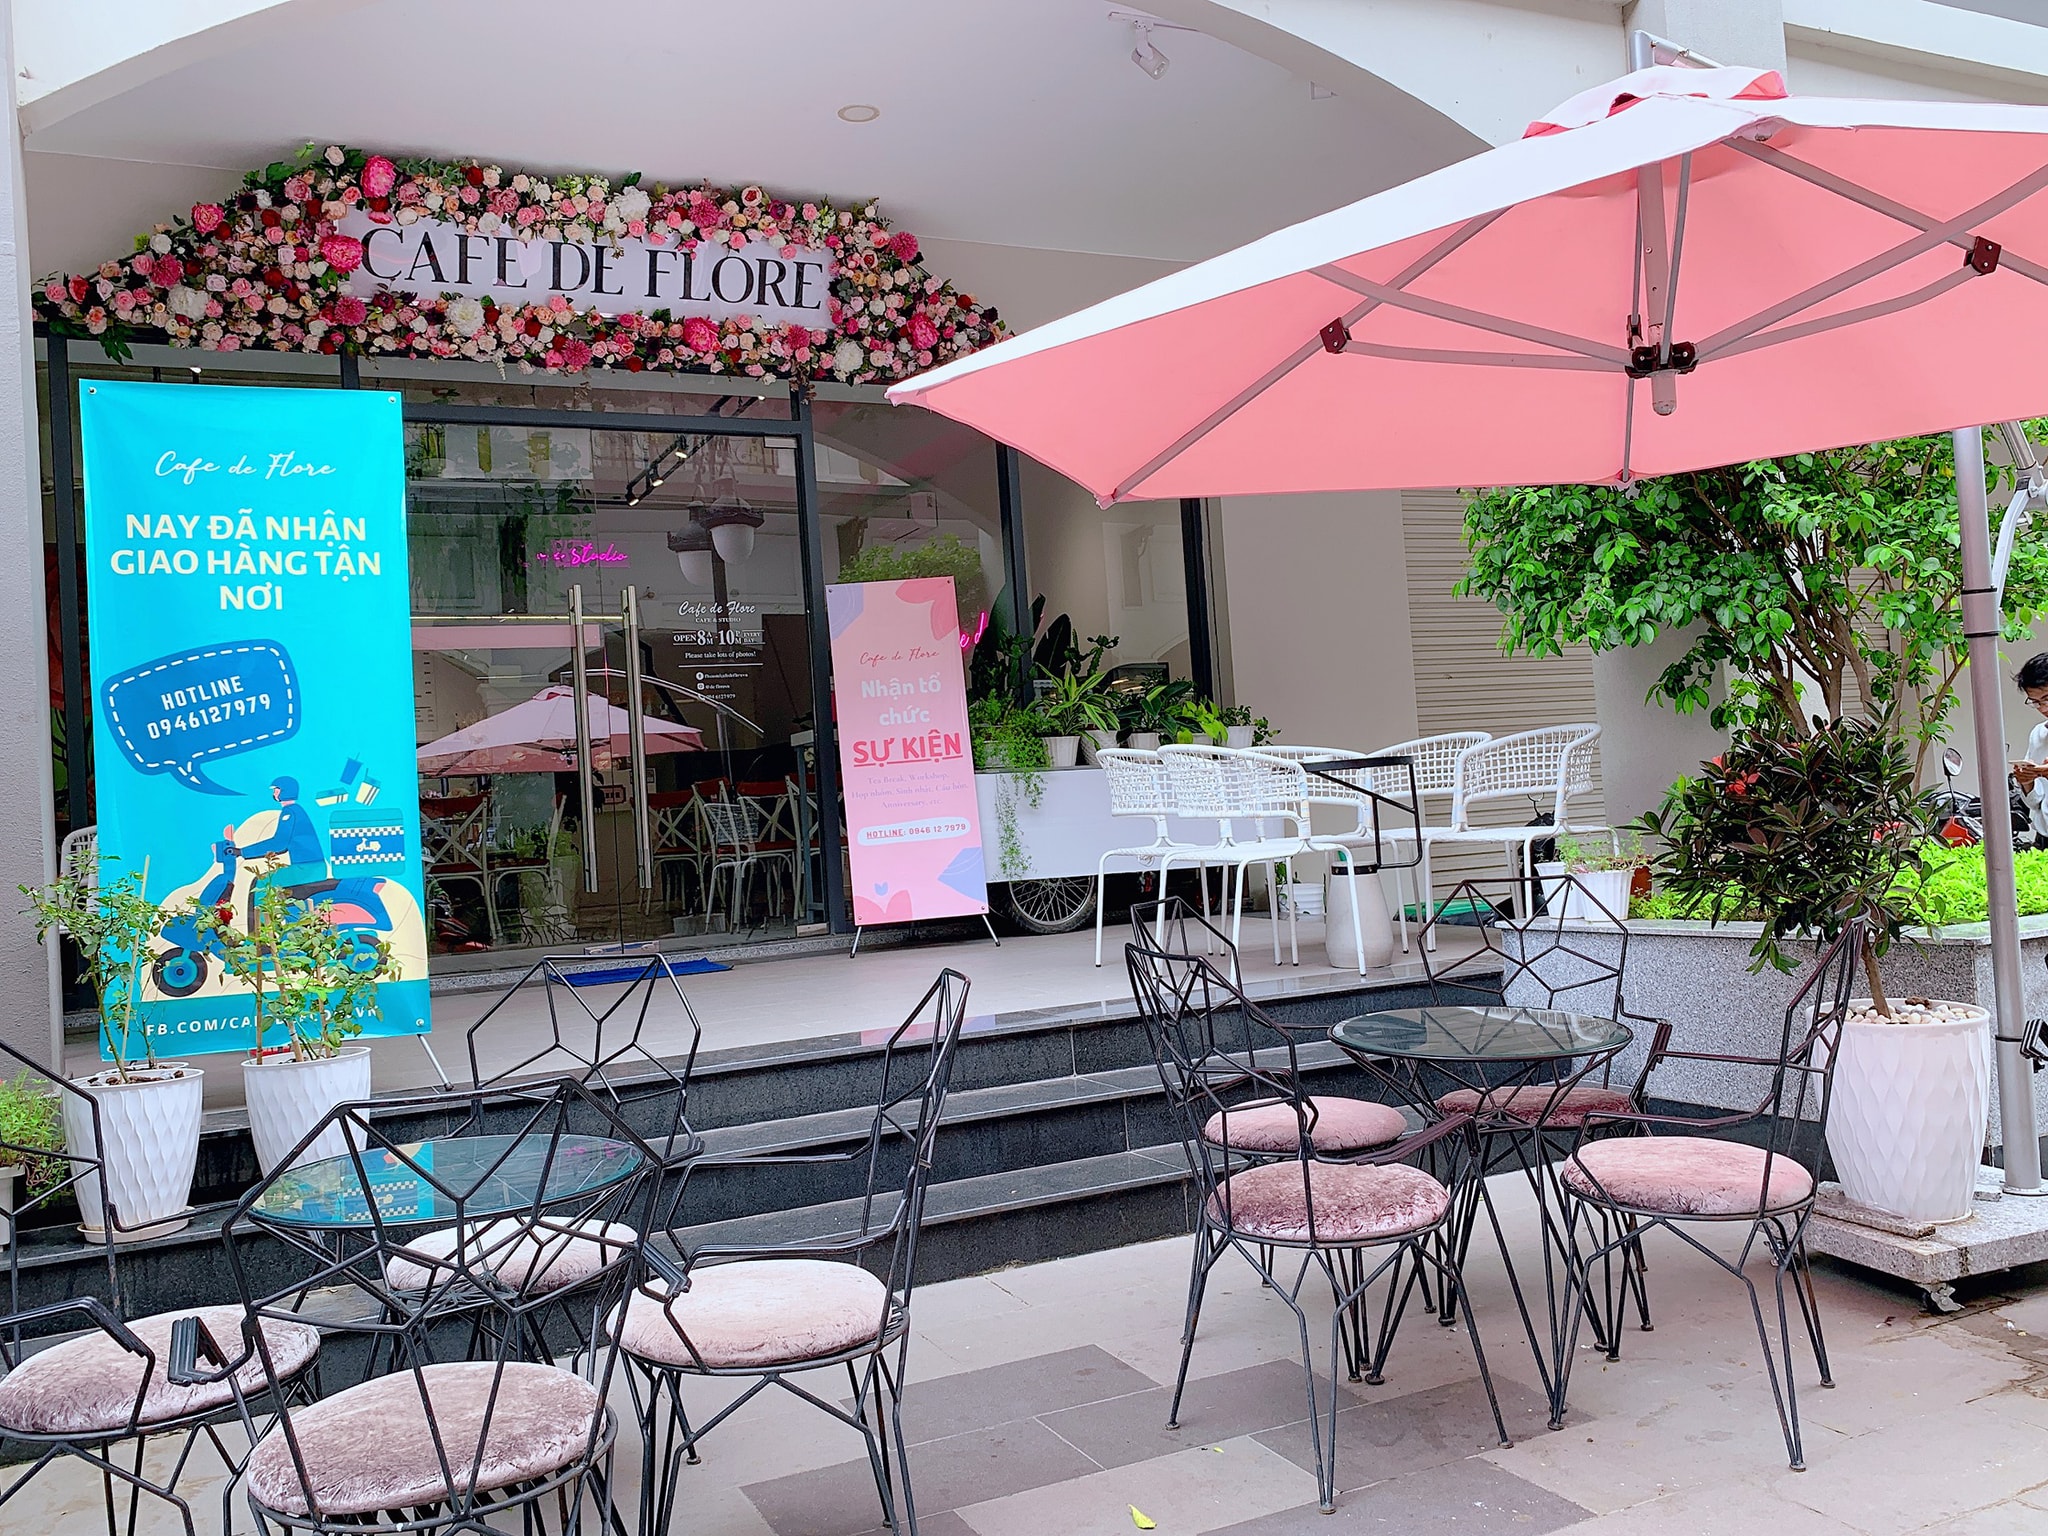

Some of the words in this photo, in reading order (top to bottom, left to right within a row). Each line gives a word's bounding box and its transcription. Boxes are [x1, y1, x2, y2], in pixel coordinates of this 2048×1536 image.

[361, 228, 528, 288] CAFE
[549, 241, 624, 295] DE
[644, 248, 823, 309] FLORE
[155, 450, 221, 485] Cafe
[228, 455, 257, 475] de
[265, 450, 336, 480] Flore
[126, 514, 200, 539] NAY
[207, 508, 258, 540] ĐÃ
[265, 509, 366, 547] NHẬN
[110, 549, 199, 575] GIAO
[207, 543, 307, 576] HÀNG
[313, 544, 381, 582] TẬN
[571, 543, 628, 565] Studio
[220, 582, 283, 611] NƠI
[678, 600, 707, 617] Cafe
[709, 602, 723, 613] de
[726, 601, 756, 615] Flore
[673, 634, 697, 642] OPEN
[860, 651, 888, 668] Cafe
[891, 651, 904, 661] de
[908, 646, 940, 662] Flore
[161, 675, 244, 711] HOTLINE
[861, 677, 914, 700] Nhận
[918, 671, 941, 693] tổ
[147, 693, 271, 740] 0946127979
[880, 704, 930, 726] chức
[853, 737, 895, 768] SỰ
[902, 729, 962, 763] KIỆN
[867, 776, 881, 785] Tea
[895, 786, 912, 795] Sinh
[909, 826, 931, 836] 0946
[934, 825, 943, 833] 12
[945, 823, 967, 832] 7979
